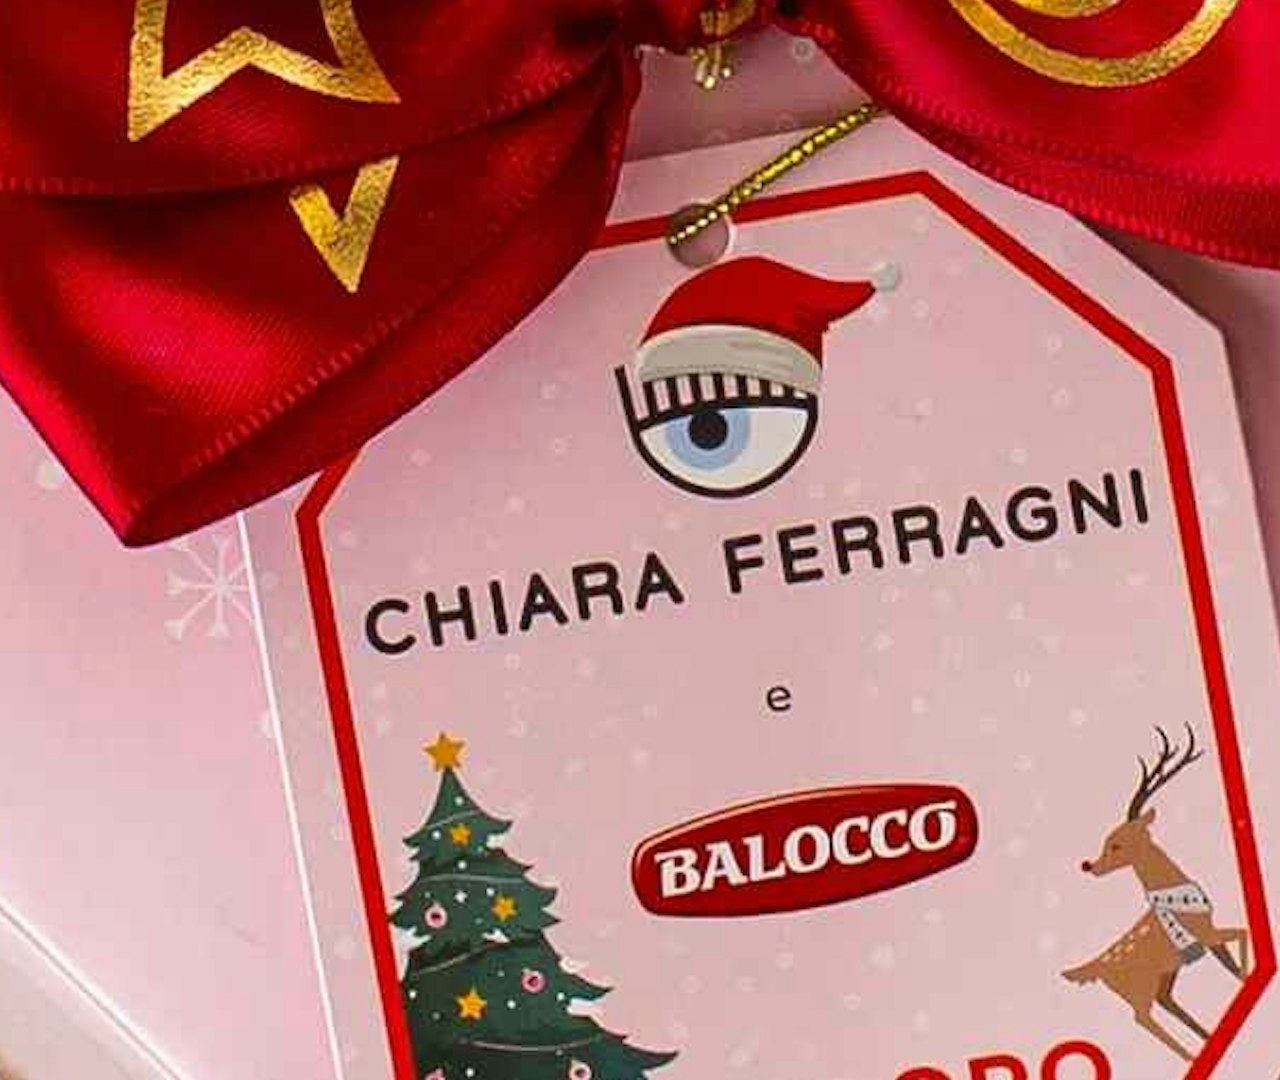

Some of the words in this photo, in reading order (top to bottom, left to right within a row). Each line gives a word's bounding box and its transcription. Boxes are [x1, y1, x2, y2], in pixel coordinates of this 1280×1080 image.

[365, 552, 684, 655] CHIARA
[722, 468, 1148, 594] FERRAGNI
[766, 685, 791, 712] e
[654, 800, 957, 897] BALOCCO
